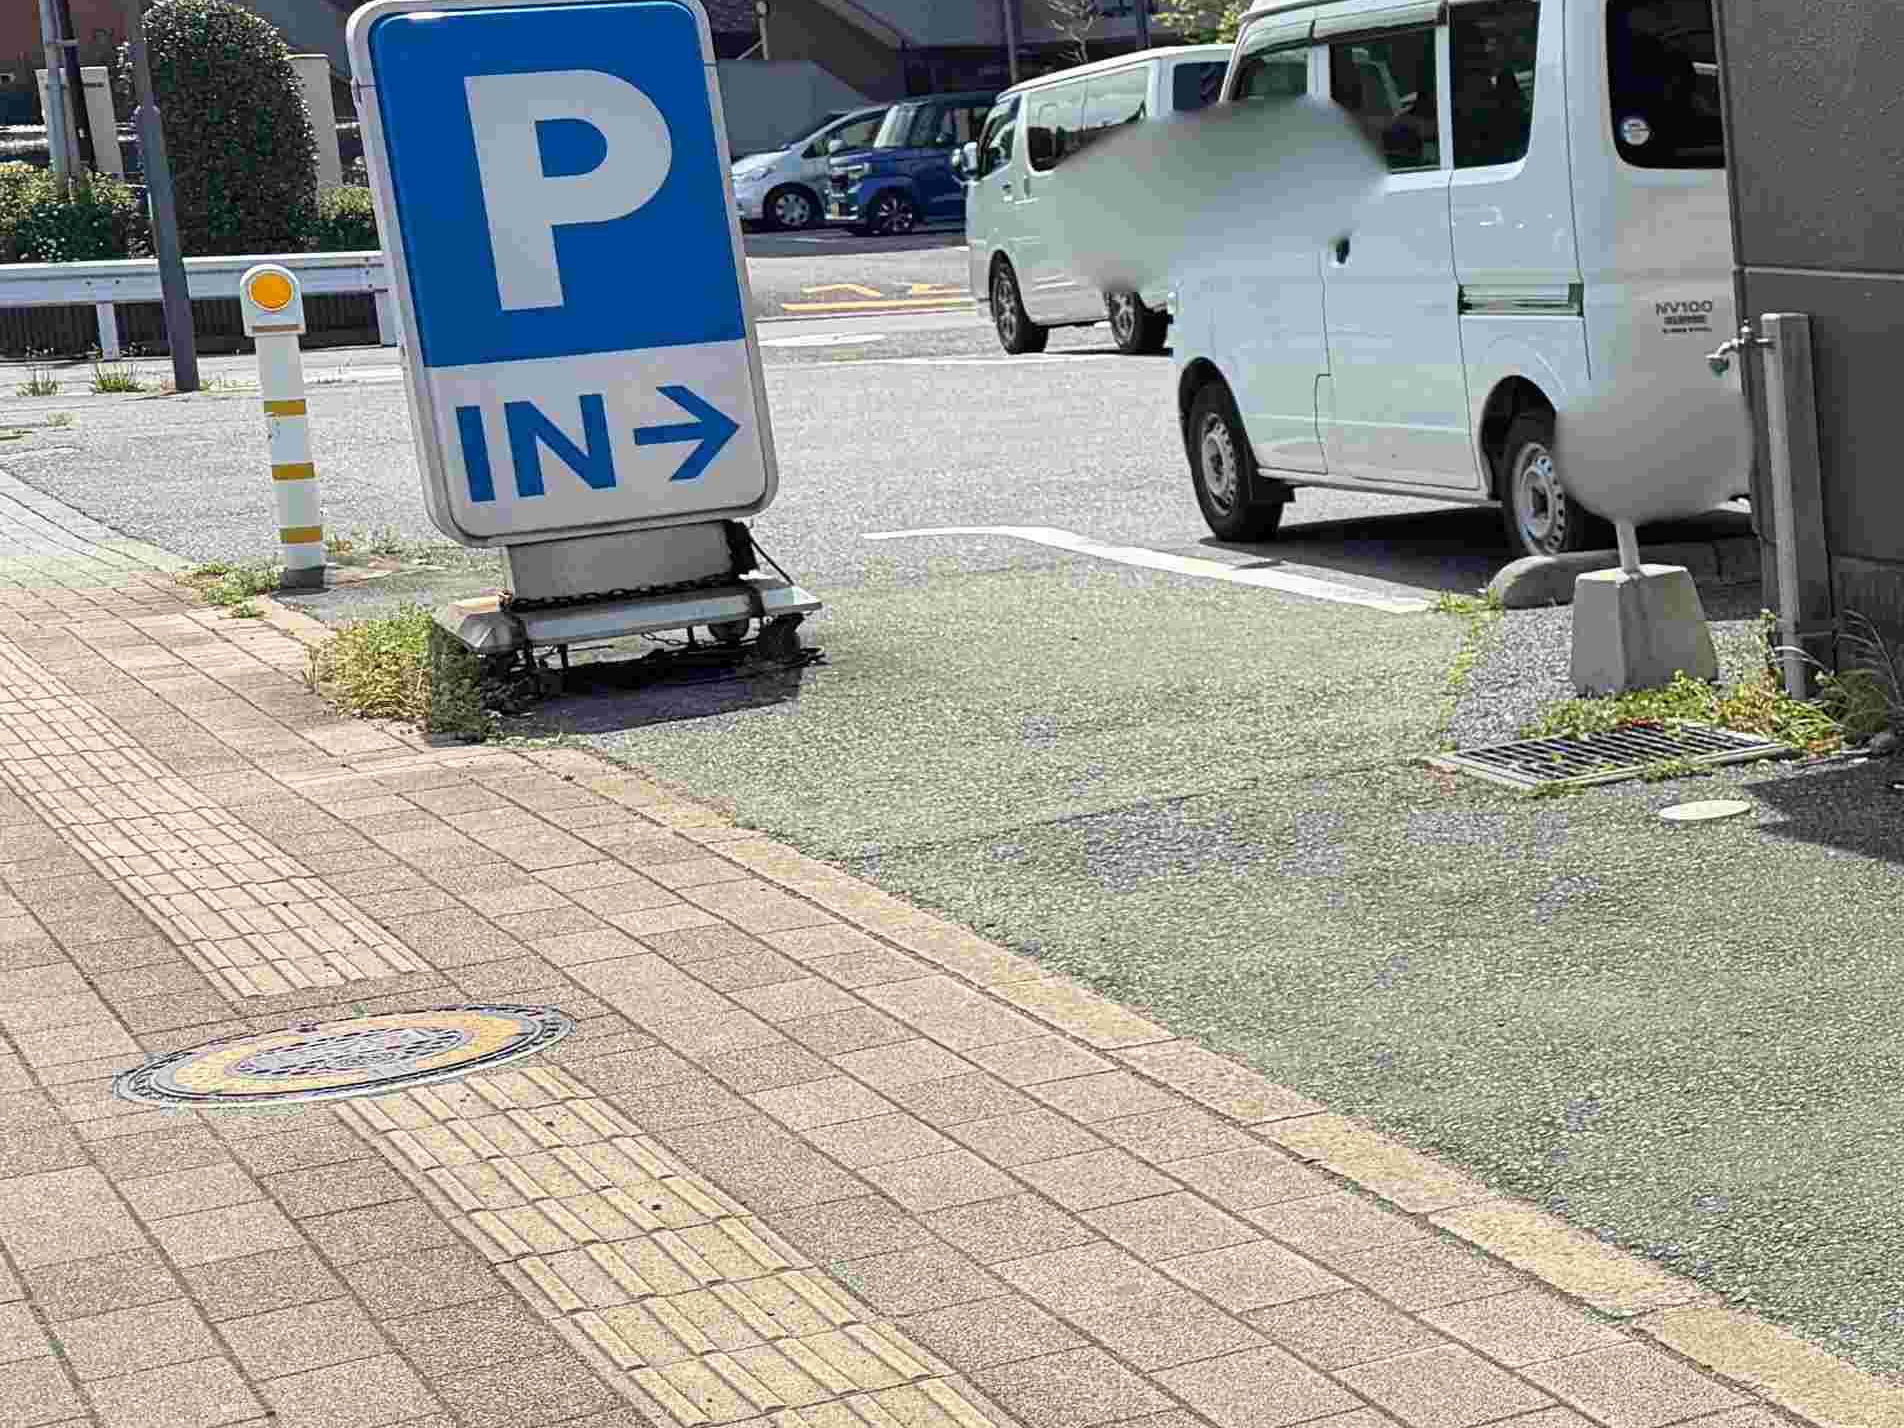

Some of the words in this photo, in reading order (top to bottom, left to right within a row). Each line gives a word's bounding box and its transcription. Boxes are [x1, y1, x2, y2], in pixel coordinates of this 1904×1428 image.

[463, 68, 673, 311] P
[1655, 299, 1713, 317] NV100
[455, 393, 616, 503] IN
